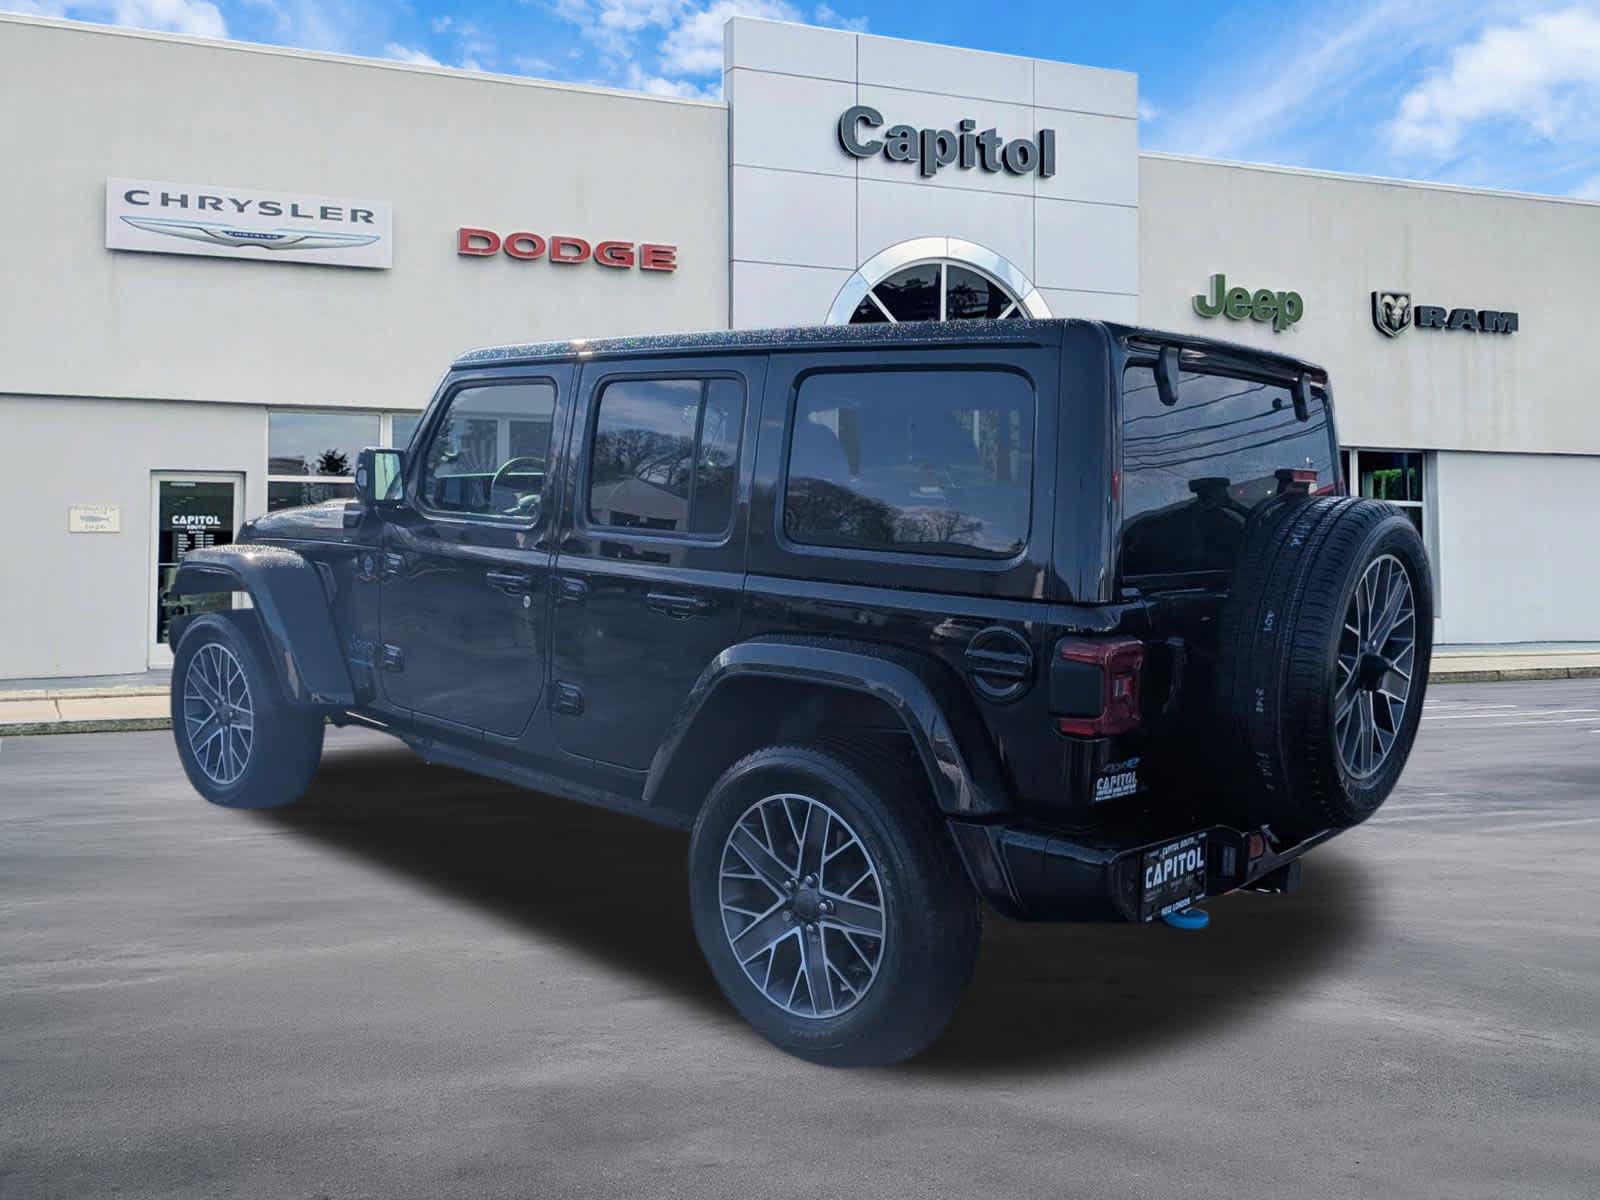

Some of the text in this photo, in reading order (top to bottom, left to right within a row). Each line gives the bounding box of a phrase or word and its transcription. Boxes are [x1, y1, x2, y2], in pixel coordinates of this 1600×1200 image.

[838, 105, 1056, 178] Capitol
[124, 189, 375, 224] CHRYSLER
[457, 227, 678, 272] DODGE
[1192, 274, 1303, 333] Jeep
[1414, 305, 1519, 334] RAM
[171, 515, 221, 525] CAPITOL
[1096, 771, 1138, 790] CAPITOL
[1145, 847, 1204, 889] CAPITOL
